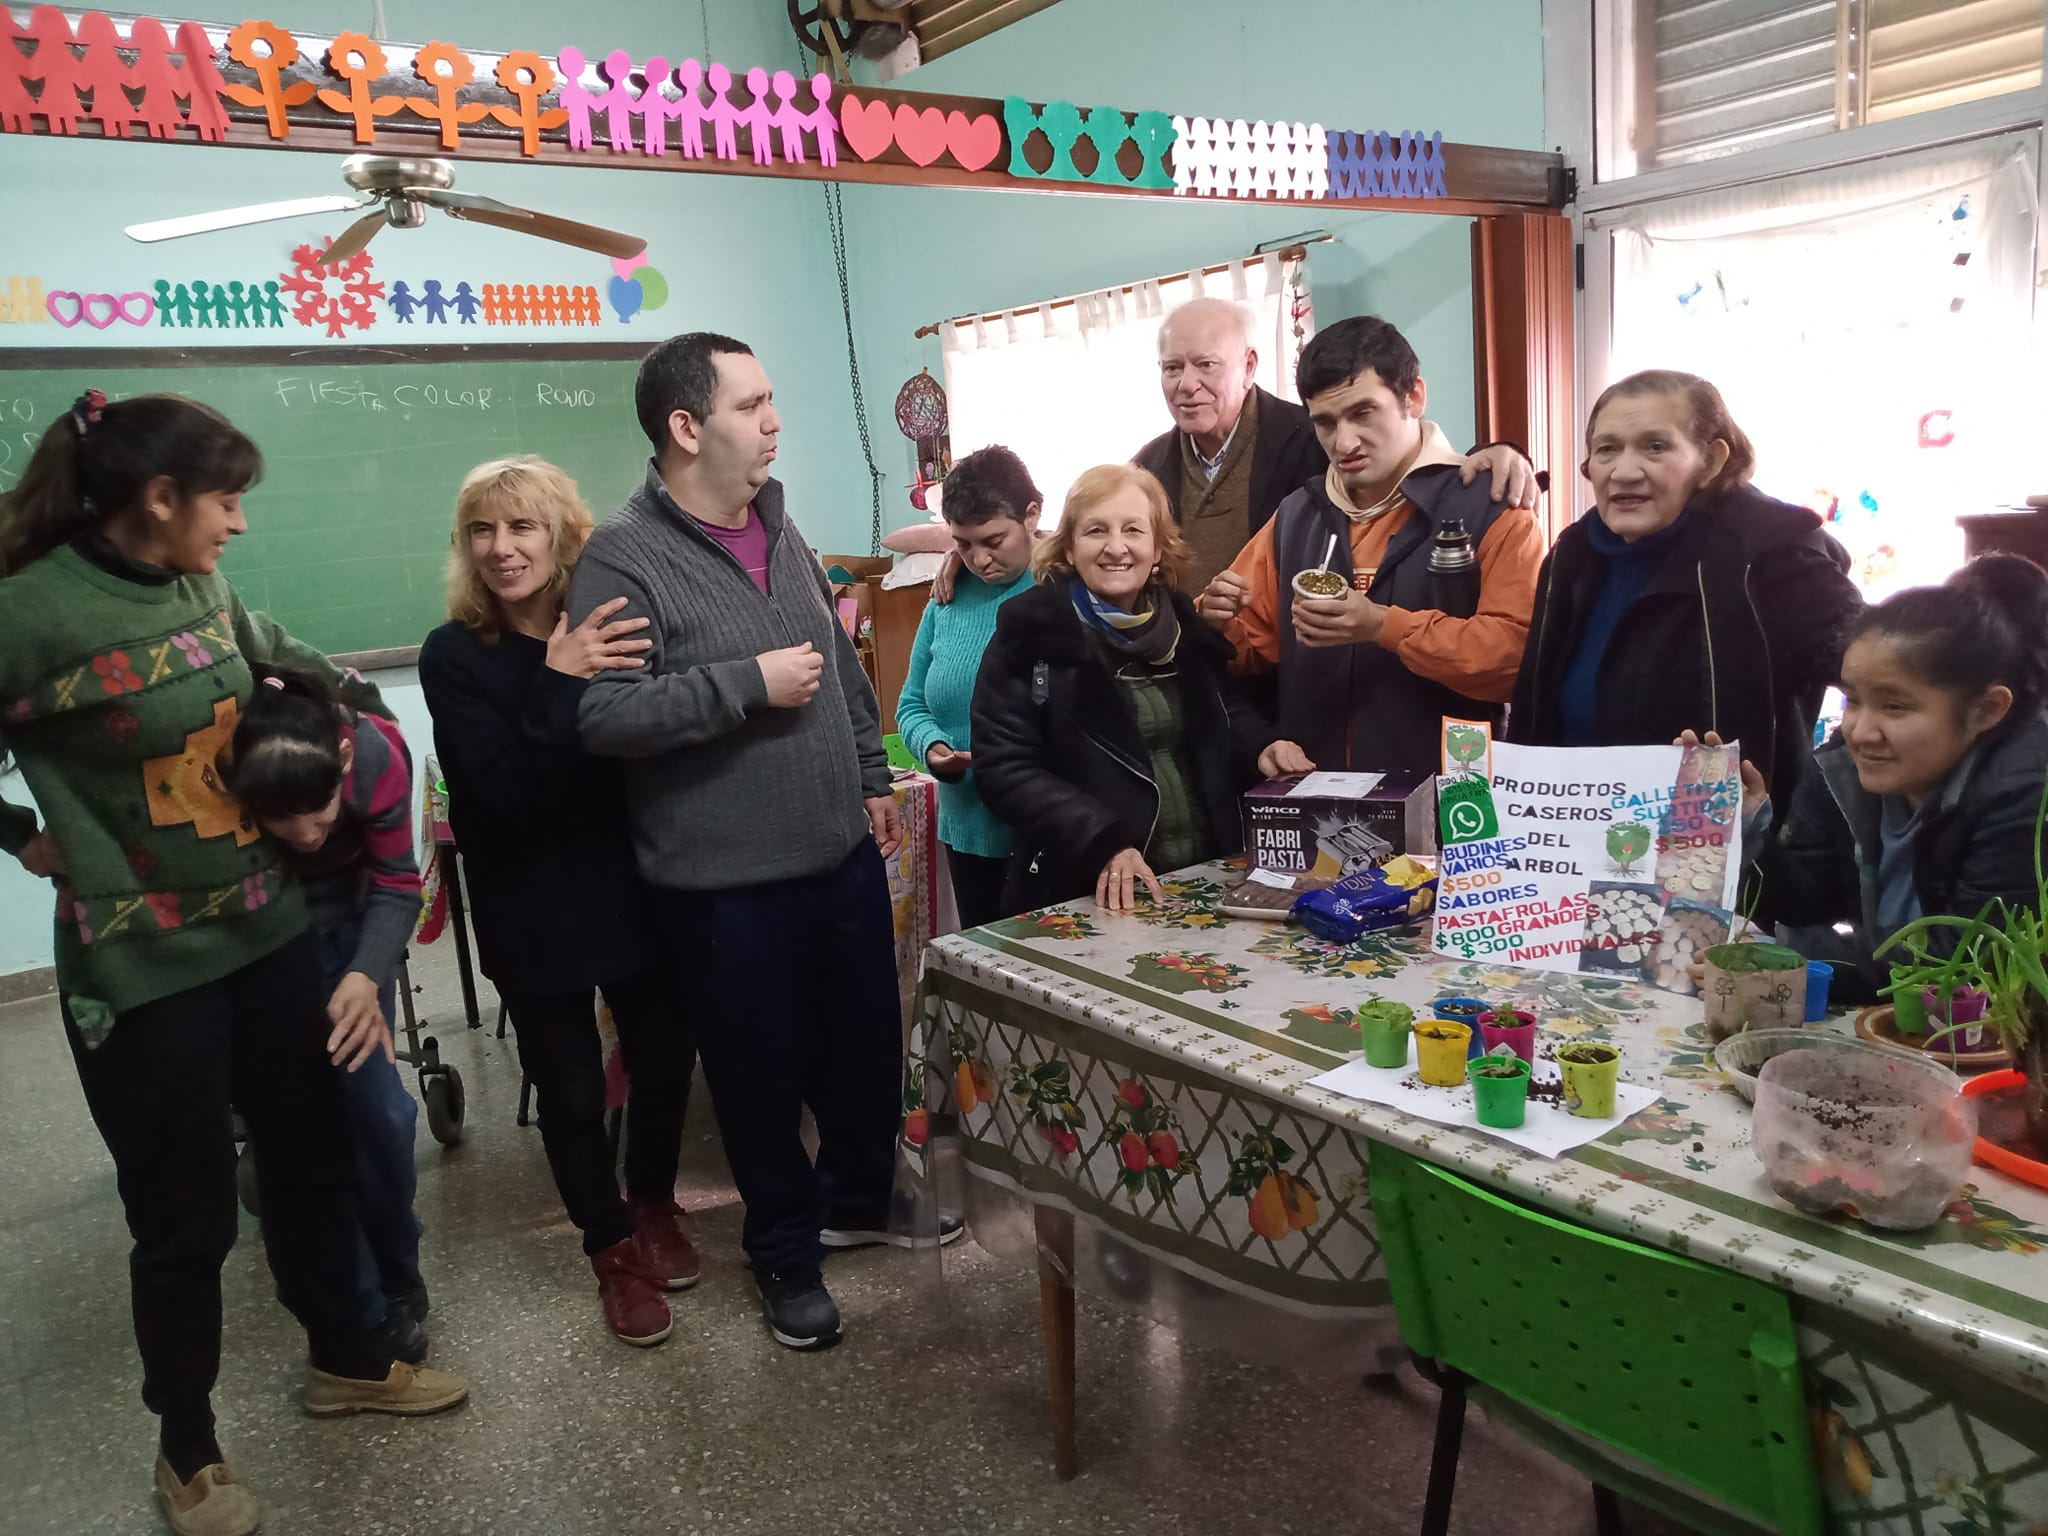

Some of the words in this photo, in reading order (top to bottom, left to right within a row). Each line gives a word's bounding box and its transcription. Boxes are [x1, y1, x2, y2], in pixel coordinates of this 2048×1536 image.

[275, 377, 386, 412] FIESTA
[393, 384, 493, 410] COLOR
[1492, 776, 1627, 797] PRODUCTOS
[1611, 777, 1739, 809] GALLETITAS
[1507, 803, 1613, 821] CASEROS
[1256, 829, 1302, 849] FABRI
[1444, 836, 1527, 862] BUDINES
[1527, 831, 1571, 848] DEL
[1257, 849, 1307, 870] PASTA
[1442, 853, 1511, 876] VARIOS
[1505, 857, 1584, 876] ARBOL
[1442, 871, 1503, 894] $500
[1438, 883, 1539, 910] SABORES
[1438, 892, 1589, 930] PASTAFROLAS
[1435, 925, 1496, 950] $800
[1497, 904, 1601, 936] GRANDES
[1461, 934, 1524, 959] $300
[1509, 929, 1663, 962] INDIVIDUALES
